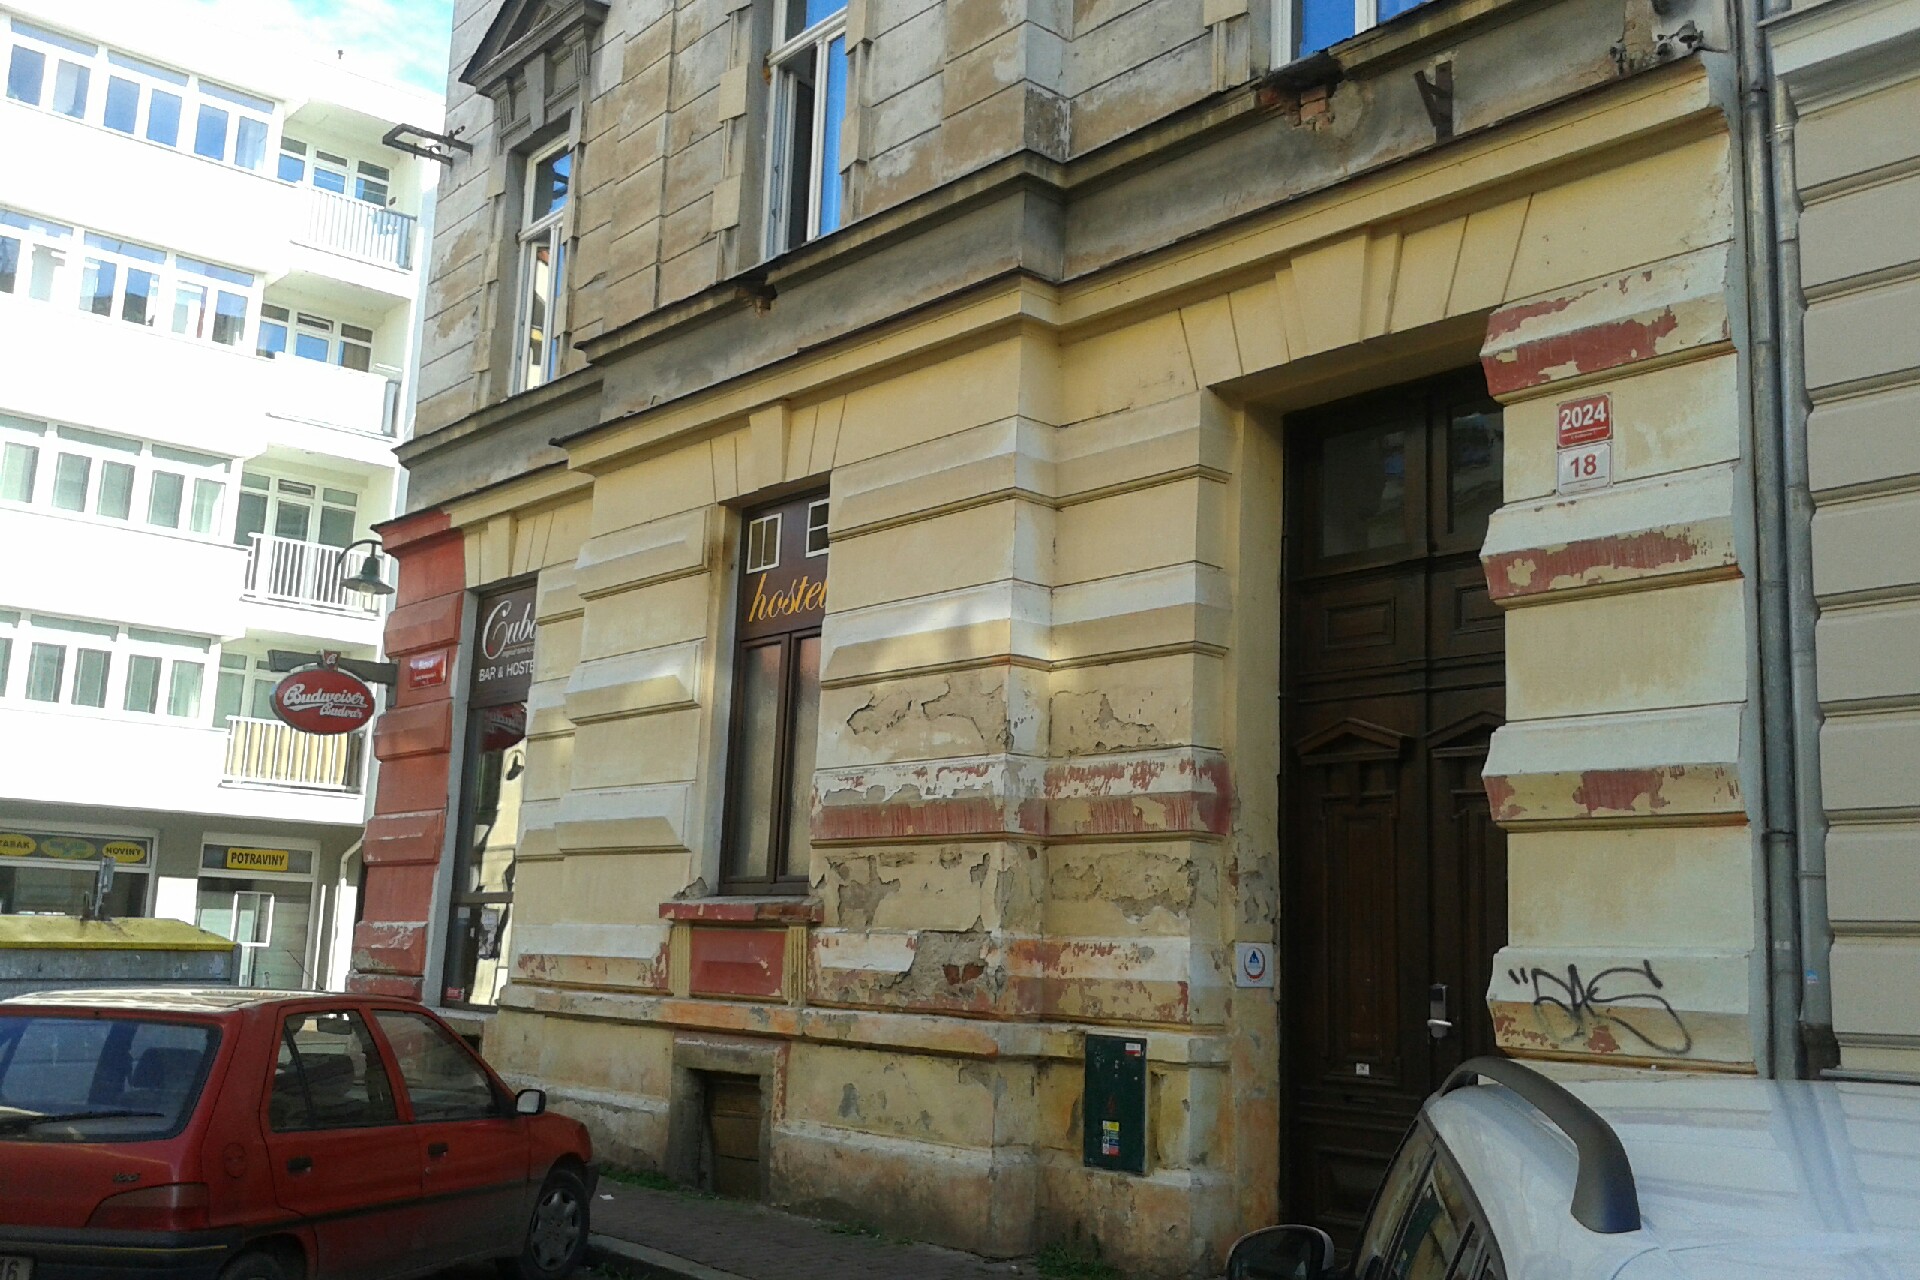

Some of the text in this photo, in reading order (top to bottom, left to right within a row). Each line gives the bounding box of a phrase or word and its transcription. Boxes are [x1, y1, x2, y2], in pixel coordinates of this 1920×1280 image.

[1561, 402, 1606, 431] 2024
[1571, 453, 1597, 478] 18
[748, 572, 829, 622] hostel
[479, 666, 496, 682] BAR
[283, 683, 366, 706] Budweiser
[319, 701, 363, 719] Budvar
[105, 846, 141, 856] NOVINY
[231, 851, 285, 867] POTRAVINY
